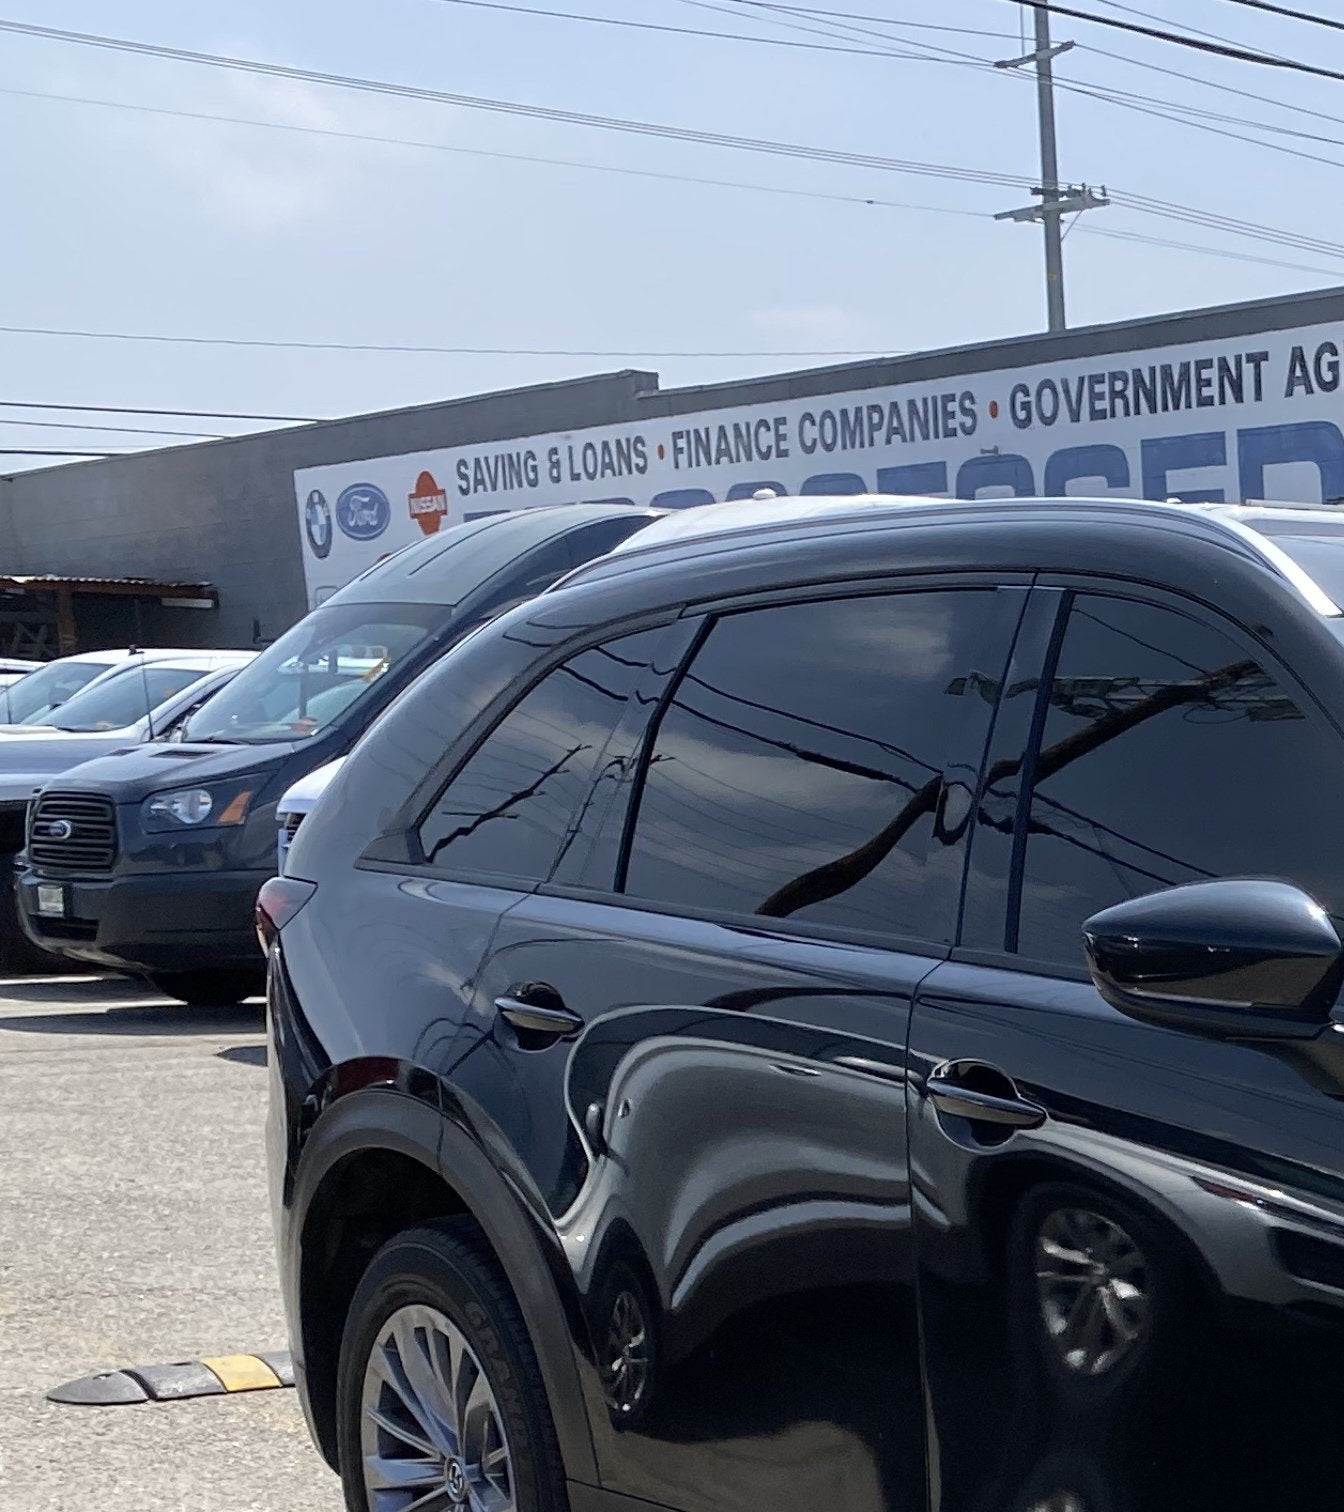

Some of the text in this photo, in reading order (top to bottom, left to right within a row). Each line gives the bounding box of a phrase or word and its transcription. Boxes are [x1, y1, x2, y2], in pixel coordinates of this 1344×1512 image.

[456, 450, 539, 496] SAVING
[548, 446, 562, 484] &
[568, 435, 649, 482] LOANS
[671, 416, 790, 470] FINANCE
[798, 390, 977, 455] COMPANIES
[1009, 350, 1269, 430] GOVERNMENT
